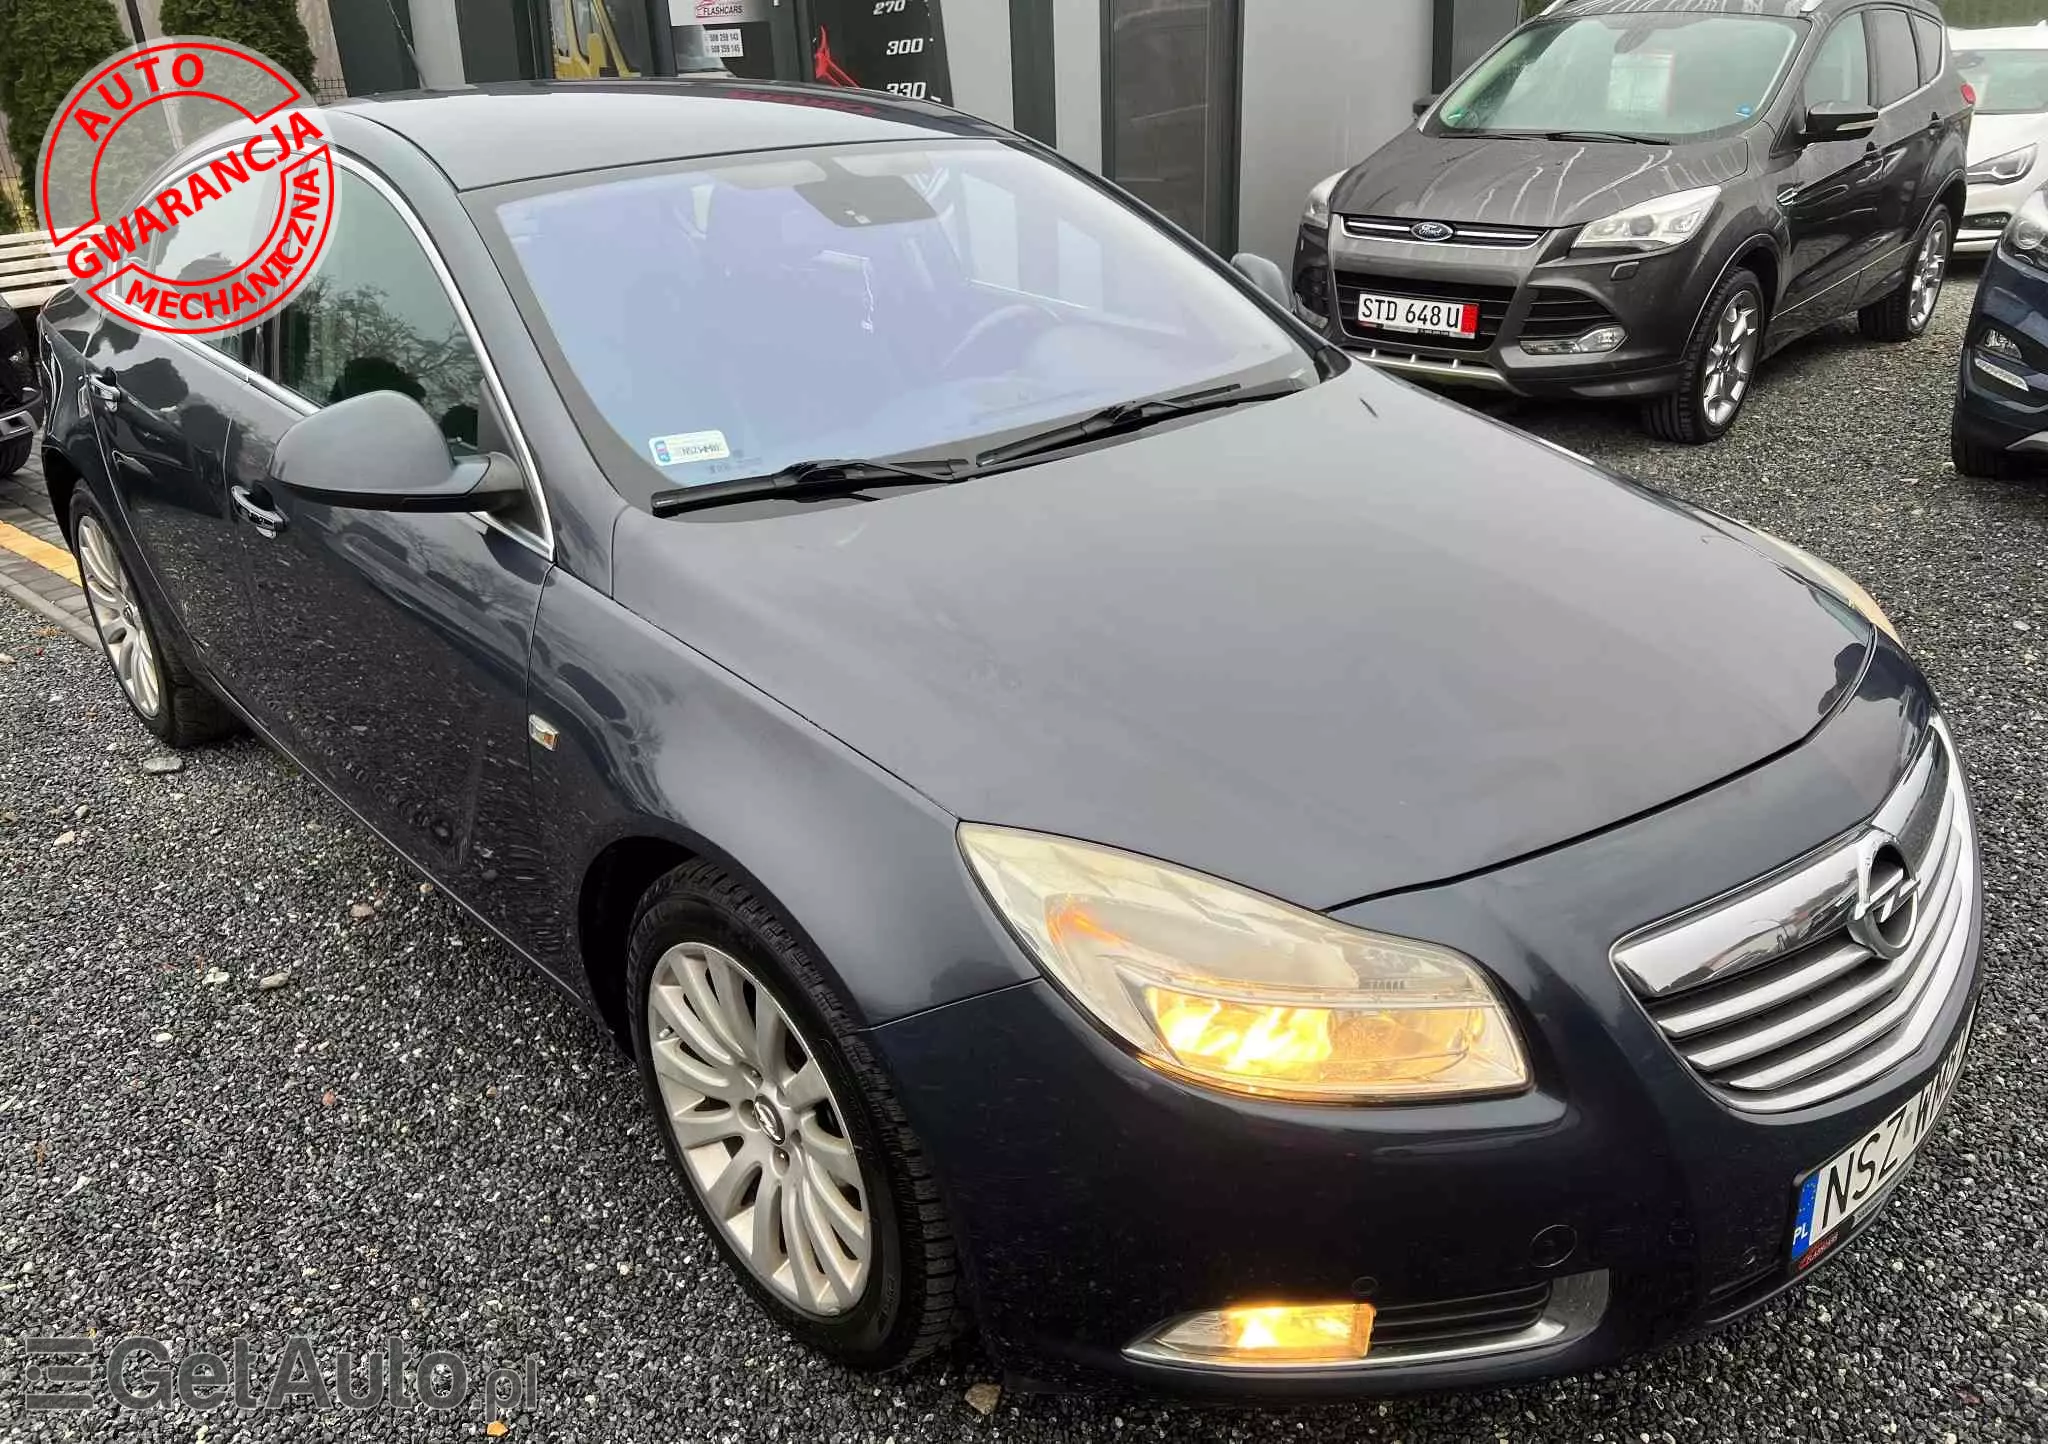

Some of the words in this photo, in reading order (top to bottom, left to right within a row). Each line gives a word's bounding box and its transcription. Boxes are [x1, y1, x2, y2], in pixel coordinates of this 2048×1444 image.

[703, 6, 743, 16] FLASHCARS
[873, 0, 906, 15] 270
[886, 38, 924, 55] 300
[886, 82, 926, 99] 330
[1362, 298, 1398, 321] STD
[1405, 303, 1441, 326] 648
[1446, 306, 1460, 329] U
[1821, 1105, 1907, 1229] NSZ
[1793, 1222, 1809, 1245] PL
